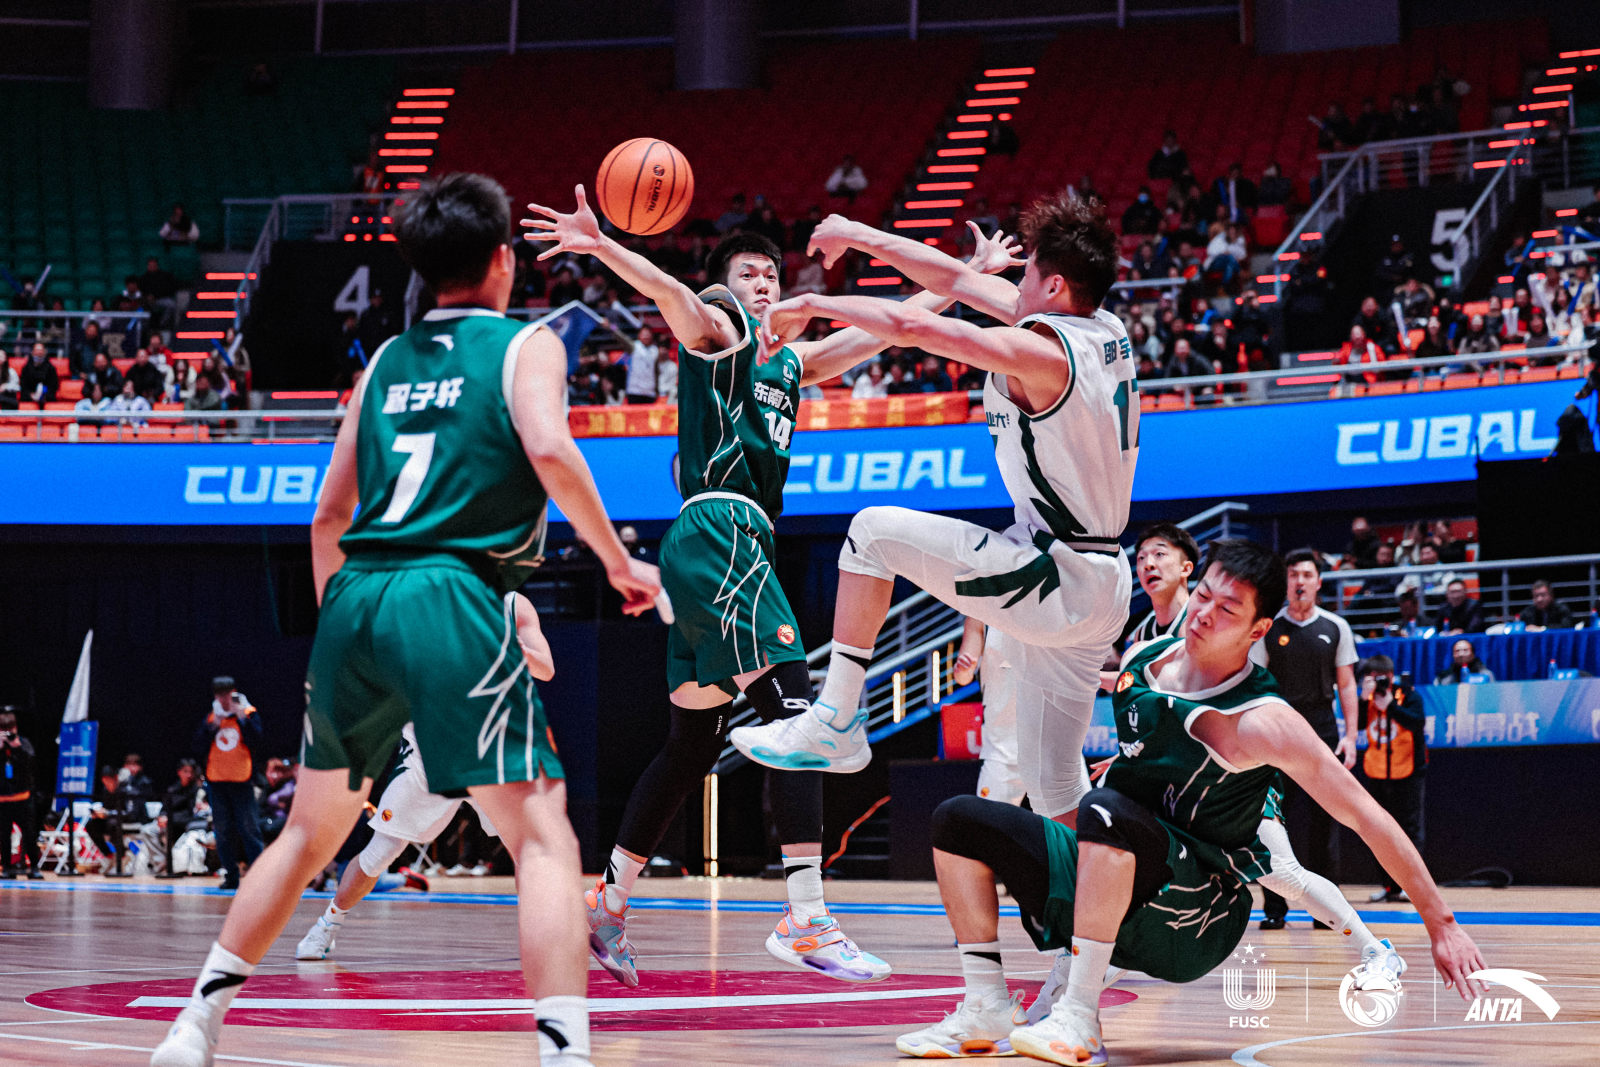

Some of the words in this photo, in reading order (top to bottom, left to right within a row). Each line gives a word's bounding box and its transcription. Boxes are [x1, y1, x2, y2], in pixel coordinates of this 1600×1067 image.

[646, 178, 663, 214] CUBAL
[1430, 208, 1470, 271] 5
[334, 265, 370, 319] 4
[764, 411, 792, 451] 14
[1336, 408, 1559, 465] CUBAL
[184, 466, 331, 504] CUB
[380, 432, 436, 522] 7
[783, 448, 987, 493] CUBAL
[771, 677, 784, 697] CUBAL
[715, 715, 723, 735] CUBAL
